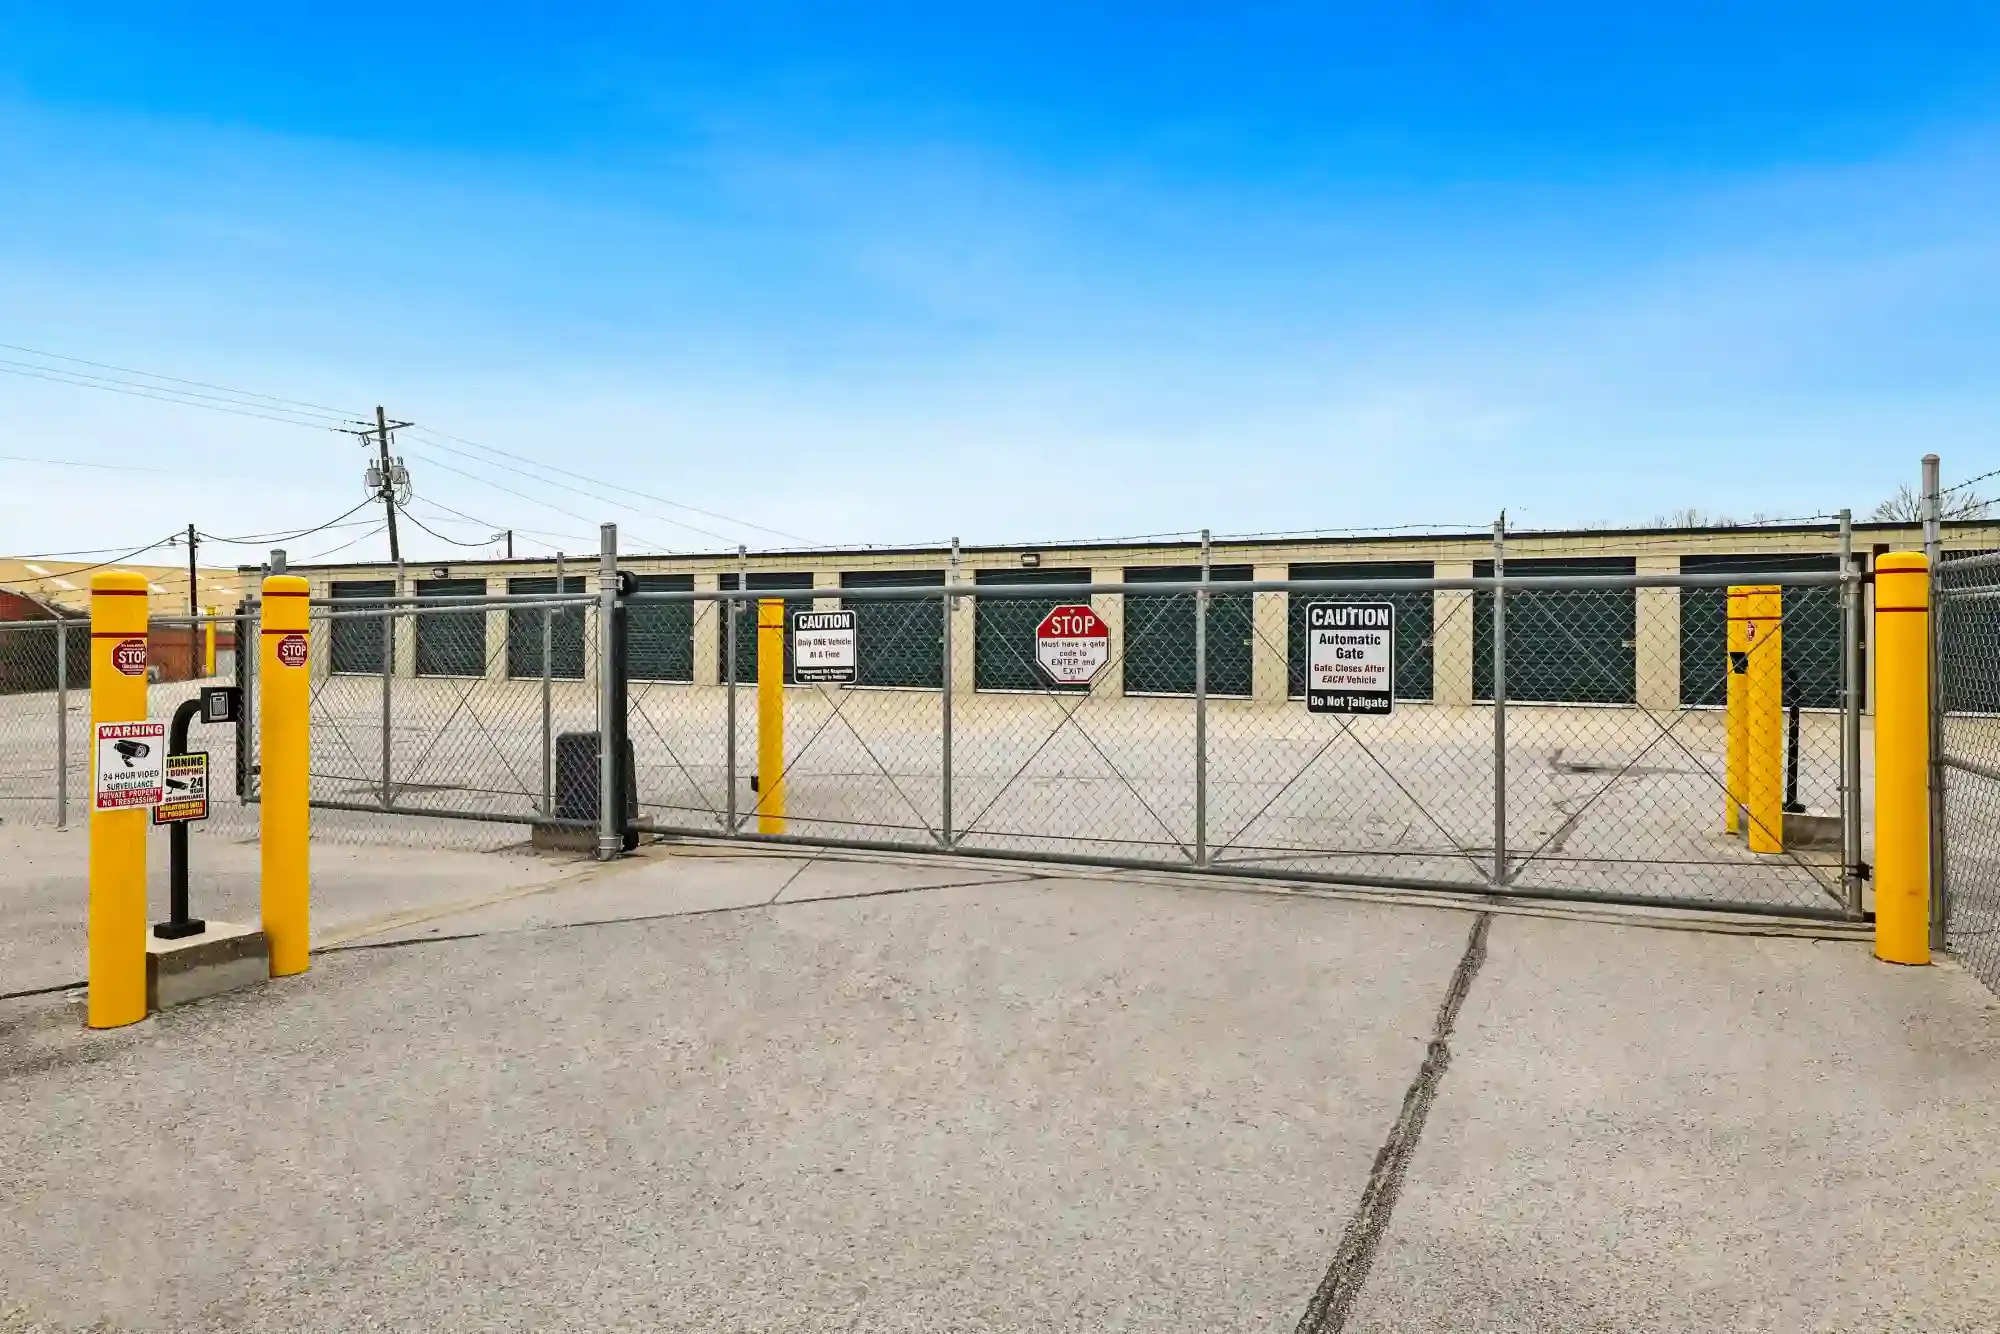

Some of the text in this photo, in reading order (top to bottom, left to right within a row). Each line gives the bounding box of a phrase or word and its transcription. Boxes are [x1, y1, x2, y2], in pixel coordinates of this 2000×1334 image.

[799, 614, 850, 629] CAUTION
[1311, 608, 1389, 626] CAUTION
[1051, 615, 1096, 635] STOP
[797, 638, 852, 647] Only ONE Vehicle
[1061, 640, 1079, 648] have
[1089, 640, 1106, 649] gate
[1319, 633, 1381, 646] Automatic
[282, 644, 307, 657] STOP
[818, 651, 824, 659] A
[825, 651, 840, 659] Time
[1336, 647, 1364, 659] Gate
[118, 650, 146, 664] STOP
[1051, 658, 1096, 666] ENTER and
[1314, 663, 1385, 673] Gate Closes After
[1322, 675, 1377, 684] EACH Vehicle
[1310, 695, 1389, 710] Do Not Tailgate
[101, 724, 164, 737] WARNING
[166, 756, 204, 769] ARNING
[103, 773, 113, 781] 24
[114, 771, 136, 780] HOUR
[137, 770, 160, 778] VIDEO
[170, 767, 204, 777] DUMPING
[106, 780, 154, 791] SURVEILLANCE
[190, 777, 204, 789] 24
[99, 788, 161, 800] PRIVATE PROPERTY
[102, 799, 112, 807] NO
[115, 796, 158, 806] TRESPASSING
